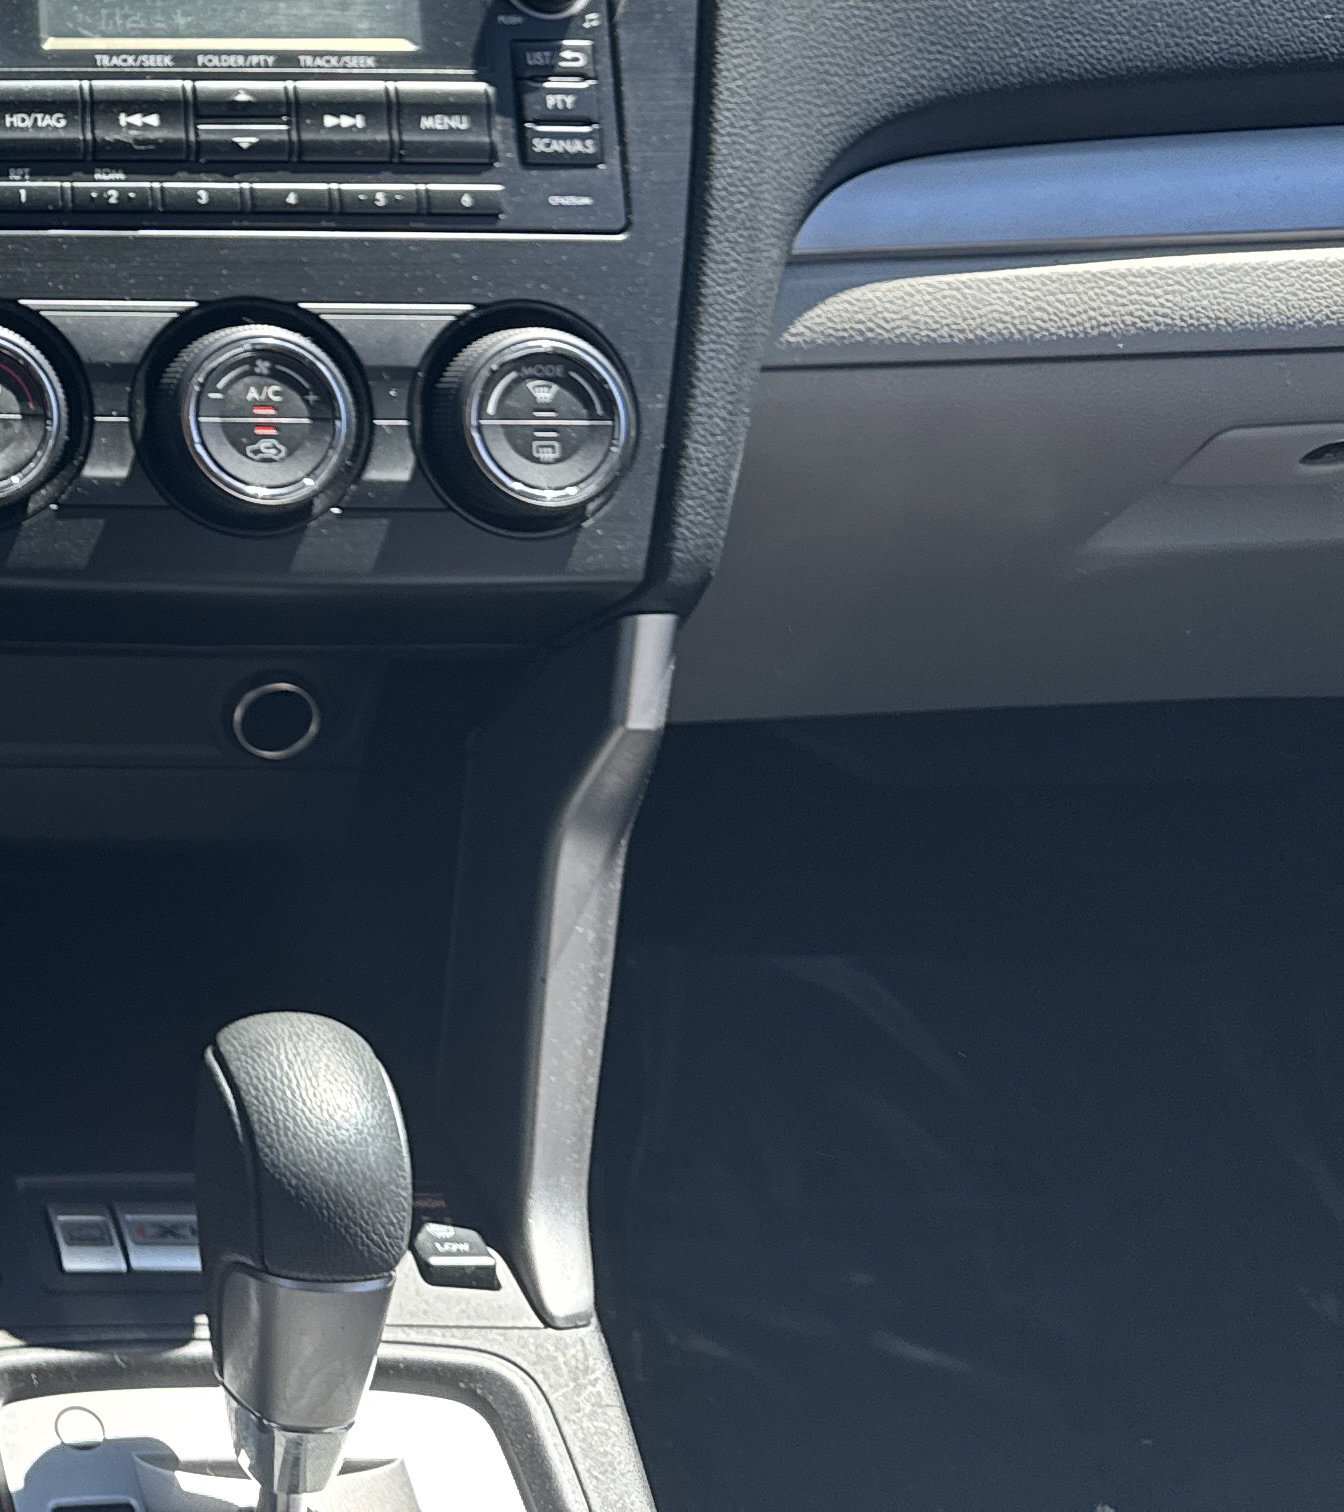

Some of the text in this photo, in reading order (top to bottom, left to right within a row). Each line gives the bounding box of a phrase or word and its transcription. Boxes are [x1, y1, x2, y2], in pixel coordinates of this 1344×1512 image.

[94, 54, 377, 68] TRACK/SEEK FOLDER/PTY TRACK/SEEK
[545, 93, 577, 110] PTY
[4, 112, 67, 129] HD/TAG
[419, 114, 472, 131] MENU
[18, 189, 28, 204] 1
[106, 190, 120, 205] 2
[196, 189, 210, 205] 3
[284, 190, 299, 206] 4
[373, 191, 388, 206] 5
[459, 192, 474, 207] 6
[245, 385, 283, 402] A/C
